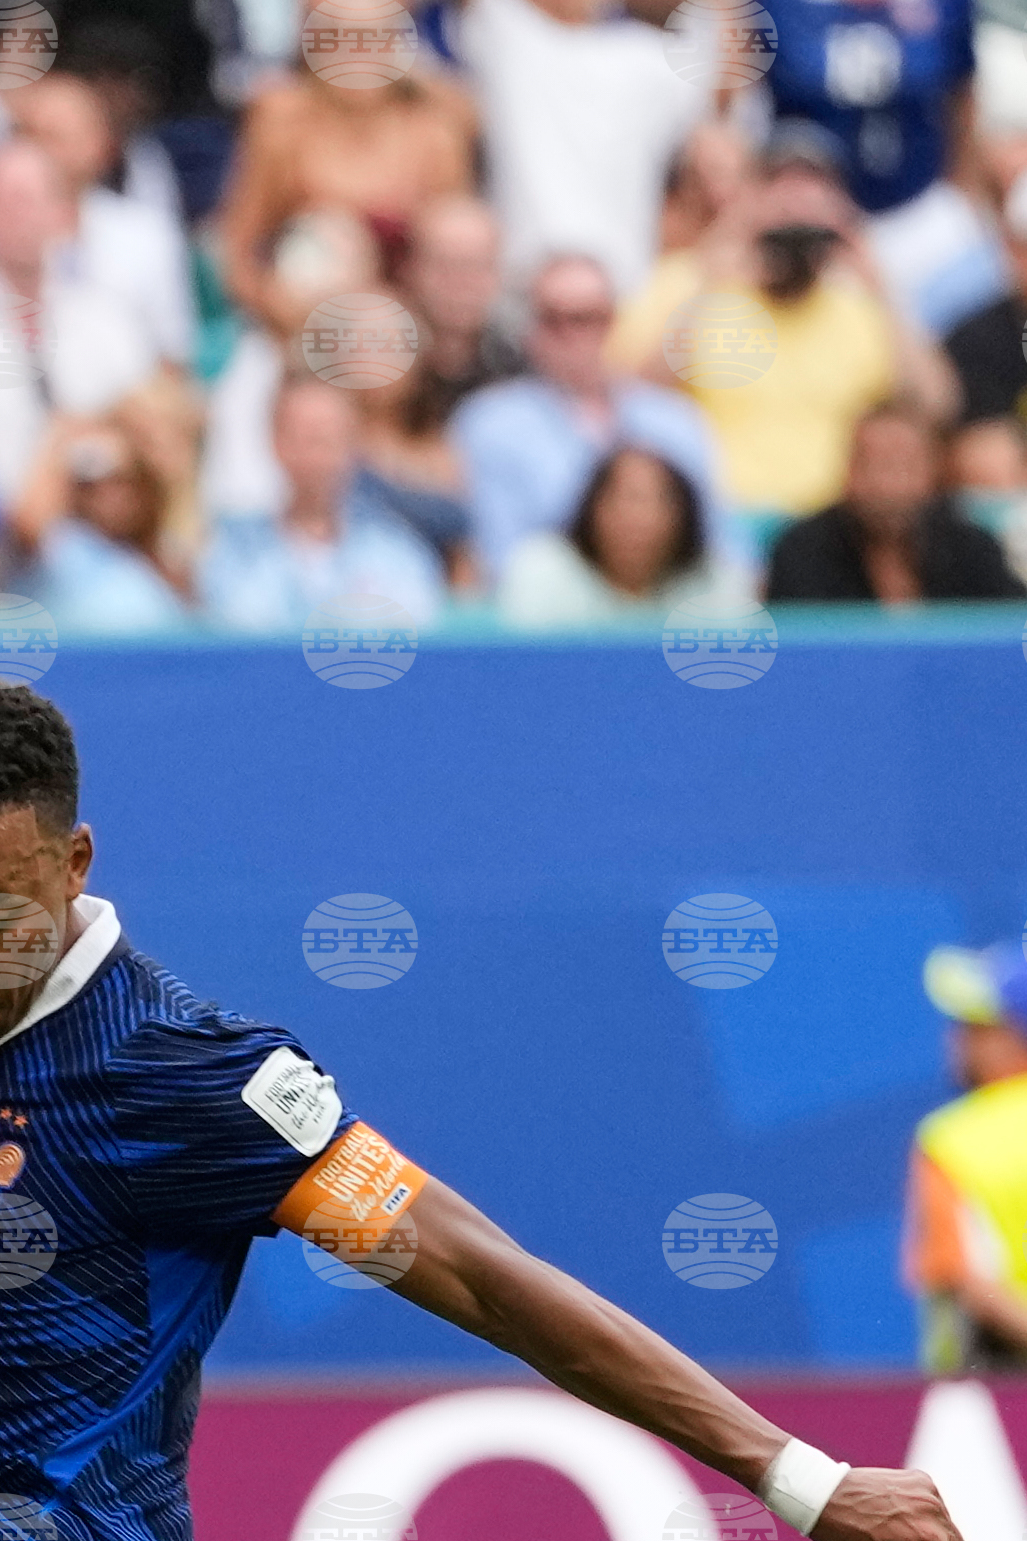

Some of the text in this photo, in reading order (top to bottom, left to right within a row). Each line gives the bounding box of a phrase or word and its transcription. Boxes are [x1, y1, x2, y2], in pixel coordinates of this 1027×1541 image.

[313, 1127, 369, 1190] FOOTBALL
[328, 1136, 390, 1203] UNITES
[351, 1194, 377, 1222] the
[385, 1187, 408, 1212] FIFA
